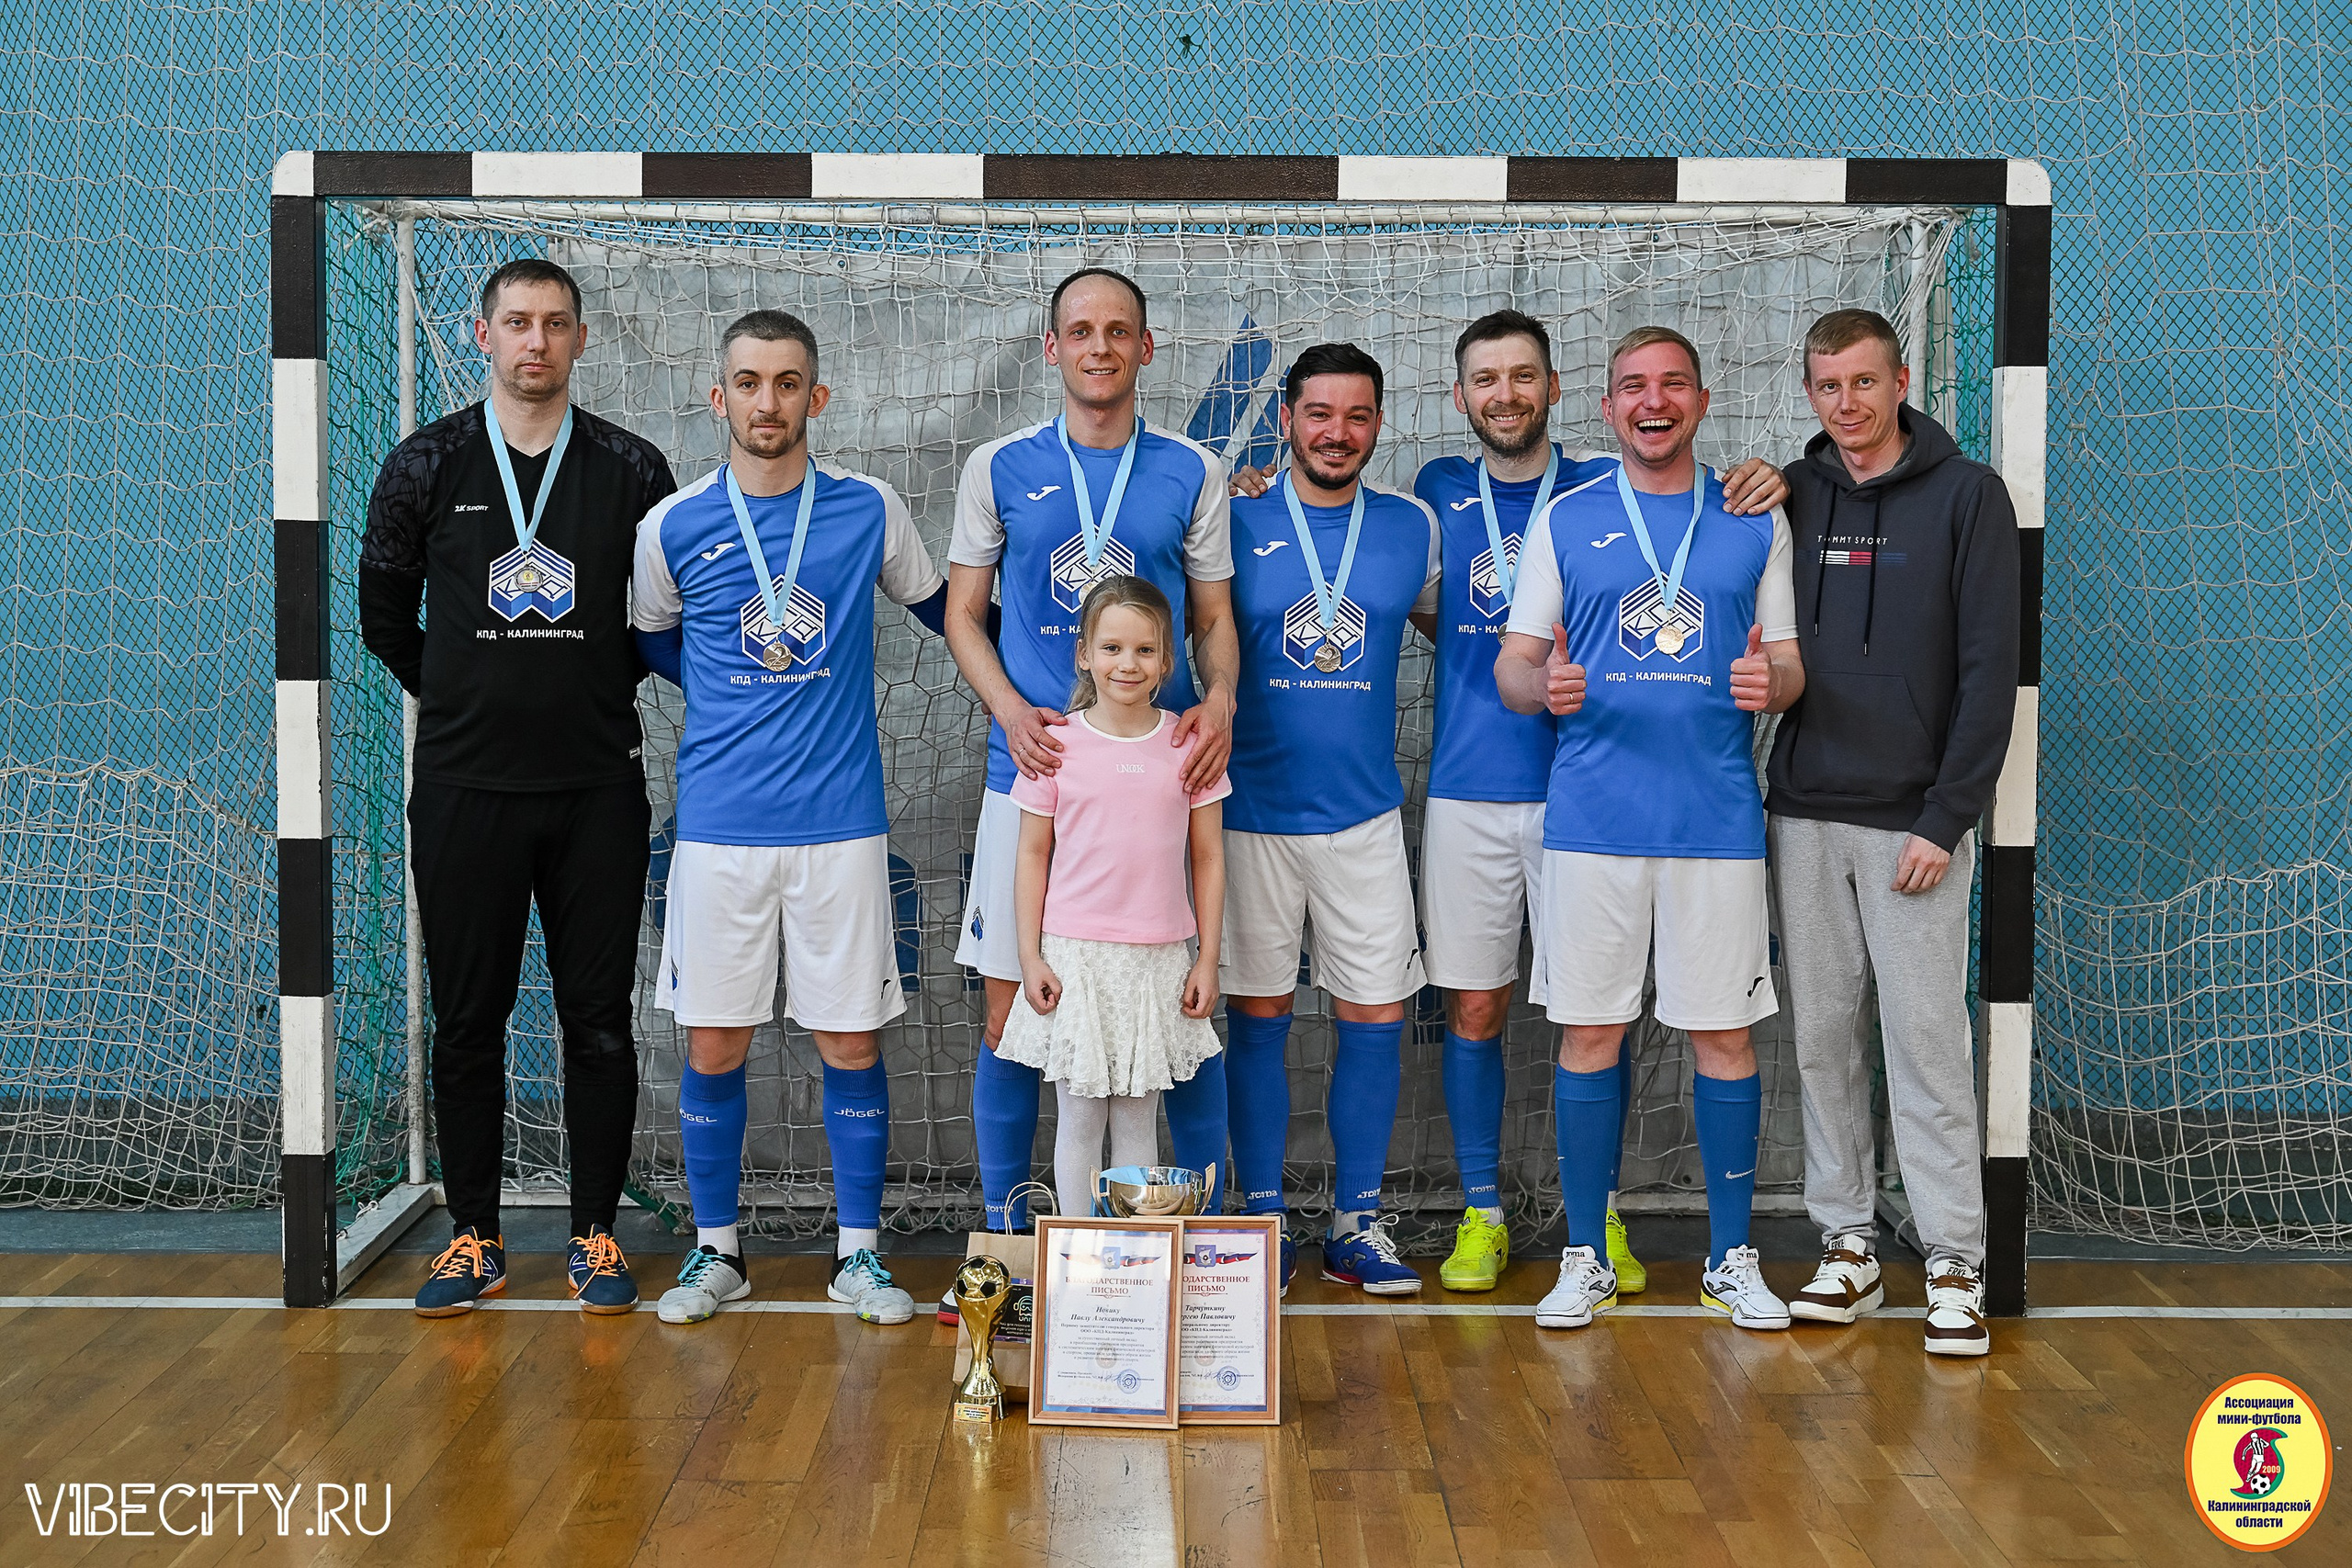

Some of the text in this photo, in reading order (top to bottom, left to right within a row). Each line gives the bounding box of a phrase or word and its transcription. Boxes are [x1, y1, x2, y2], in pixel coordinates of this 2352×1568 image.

[1855, 537, 1888, 545] SPORT
[476, 630, 496, 640] КПД
[507, 629, 584, 640] КАЛИНИНГРАД
[1040, 626, 1060, 635] КПД
[1458, 625, 1476, 634] КПД
[730, 676, 751, 685] КПД
[761, 668, 831, 683] КАЛИНИНГРАД
[1606, 673, 1626, 682] КПД
[1636, 672, 1711, 686] КАЛИНИНГРАД
[1269, 678, 1289, 689] КПД
[1300, 680, 1371, 691] КАЛИНИНГРАД
[679, 1108, 717, 1123] ÖGEL
[834, 1108, 885, 1118] JÖGEL
